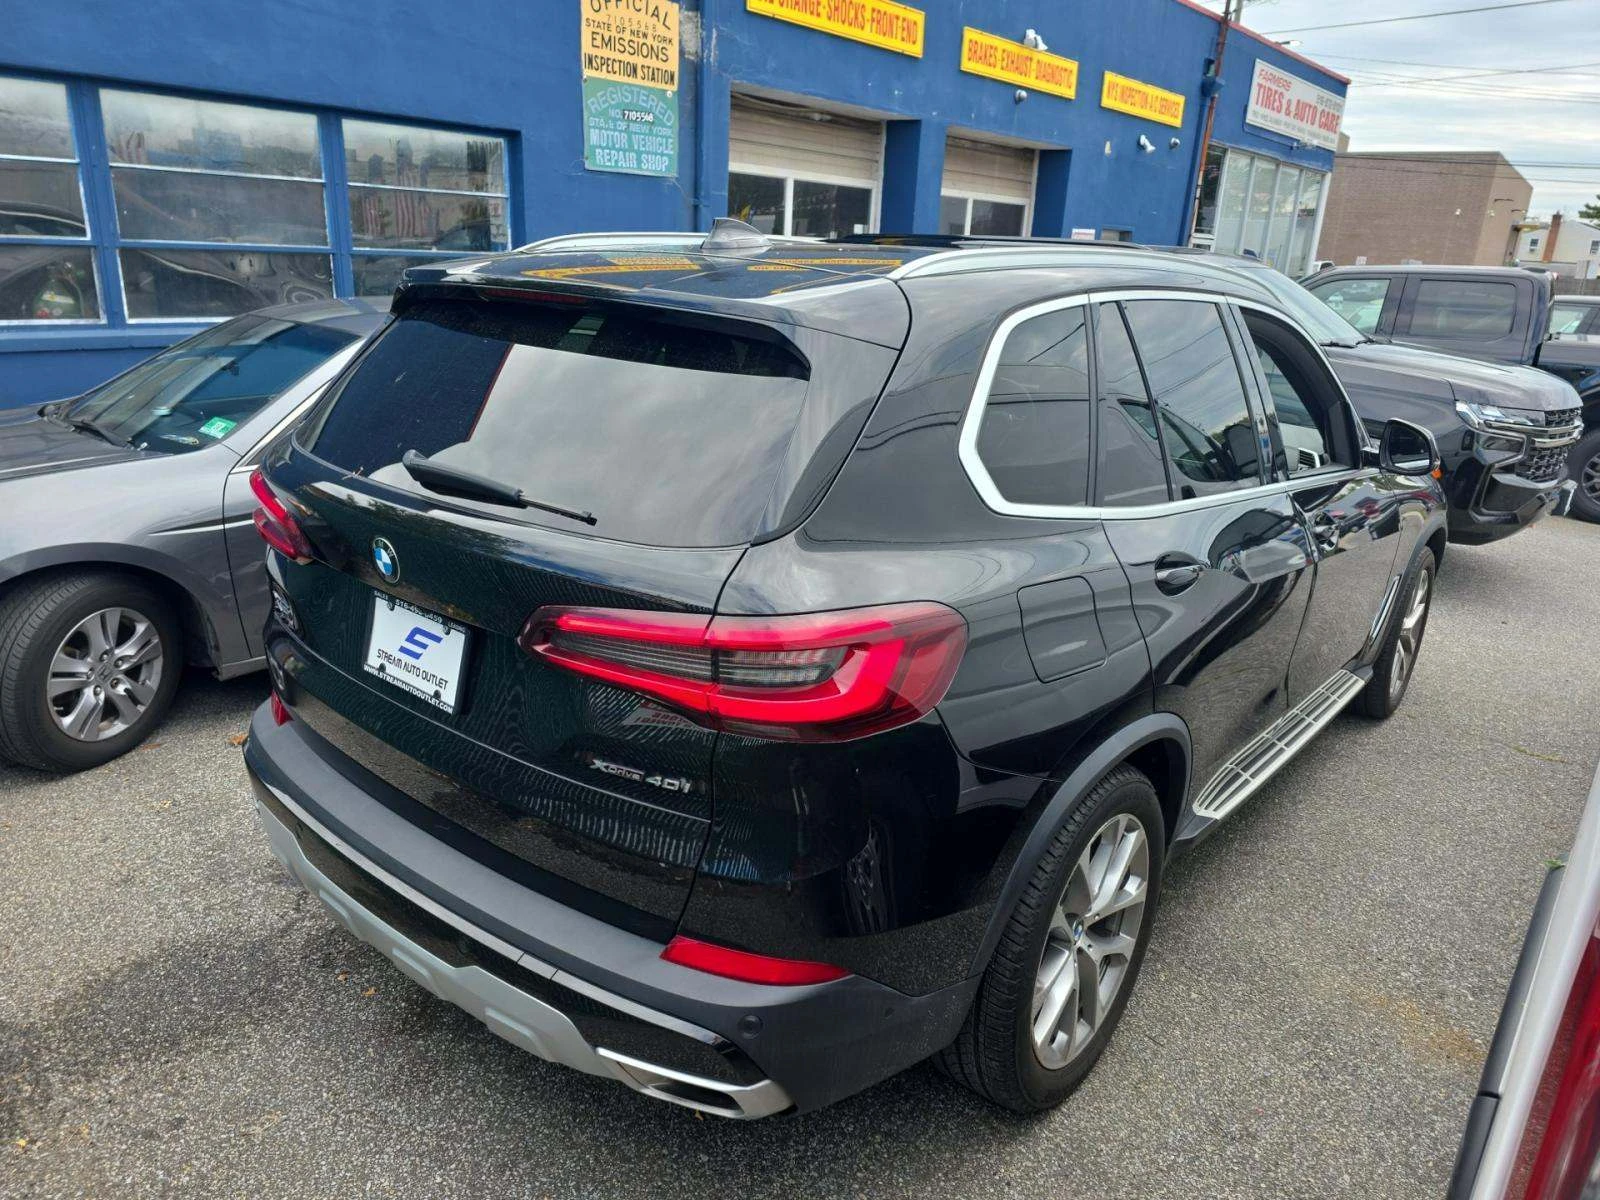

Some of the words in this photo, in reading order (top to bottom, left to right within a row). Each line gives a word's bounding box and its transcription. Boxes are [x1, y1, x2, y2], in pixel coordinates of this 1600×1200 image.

[590, 0, 671, 30] OFFICIAL
[827, 0, 866, 30] SHOCKS
[585, 18, 612, 32] STATE
[615, 25, 627, 35] OF
[629, 29, 649, 40] NEW
[651, 34, 673, 46] YORK
[591, 31, 669, 63] EMISSIONS
[584, 53, 638, 79] INSPECTION
[641, 65, 676, 86] STATION
[967, 39, 998, 70] BRAKES
[1000, 48, 1032, 83] EXHAUST
[1035, 58, 1073, 90] DIAGNOSTIC
[587, 86, 674, 126] REGISTERED
[1255, 83, 1284, 114] TIRES
[1284, 99, 1292, 118] &
[1293, 99, 1318, 126] AUTO
[1319, 108, 1340, 135] CARE
[589, 117, 614, 129] STATE
[616, 120, 628, 130] OF
[629, 123, 651, 134] NEW
[652, 125, 674, 137] YORK
[589, 128, 629, 149] MOTOR
[633, 133, 674, 154] VEHICLE
[595, 149, 638, 169] REPAIR
[641, 153, 669, 172] SHOP
[376, 648, 403, 670] STREAM
[403, 661, 421, 678] AUTO
[421, 670, 449, 691] OUTLET
